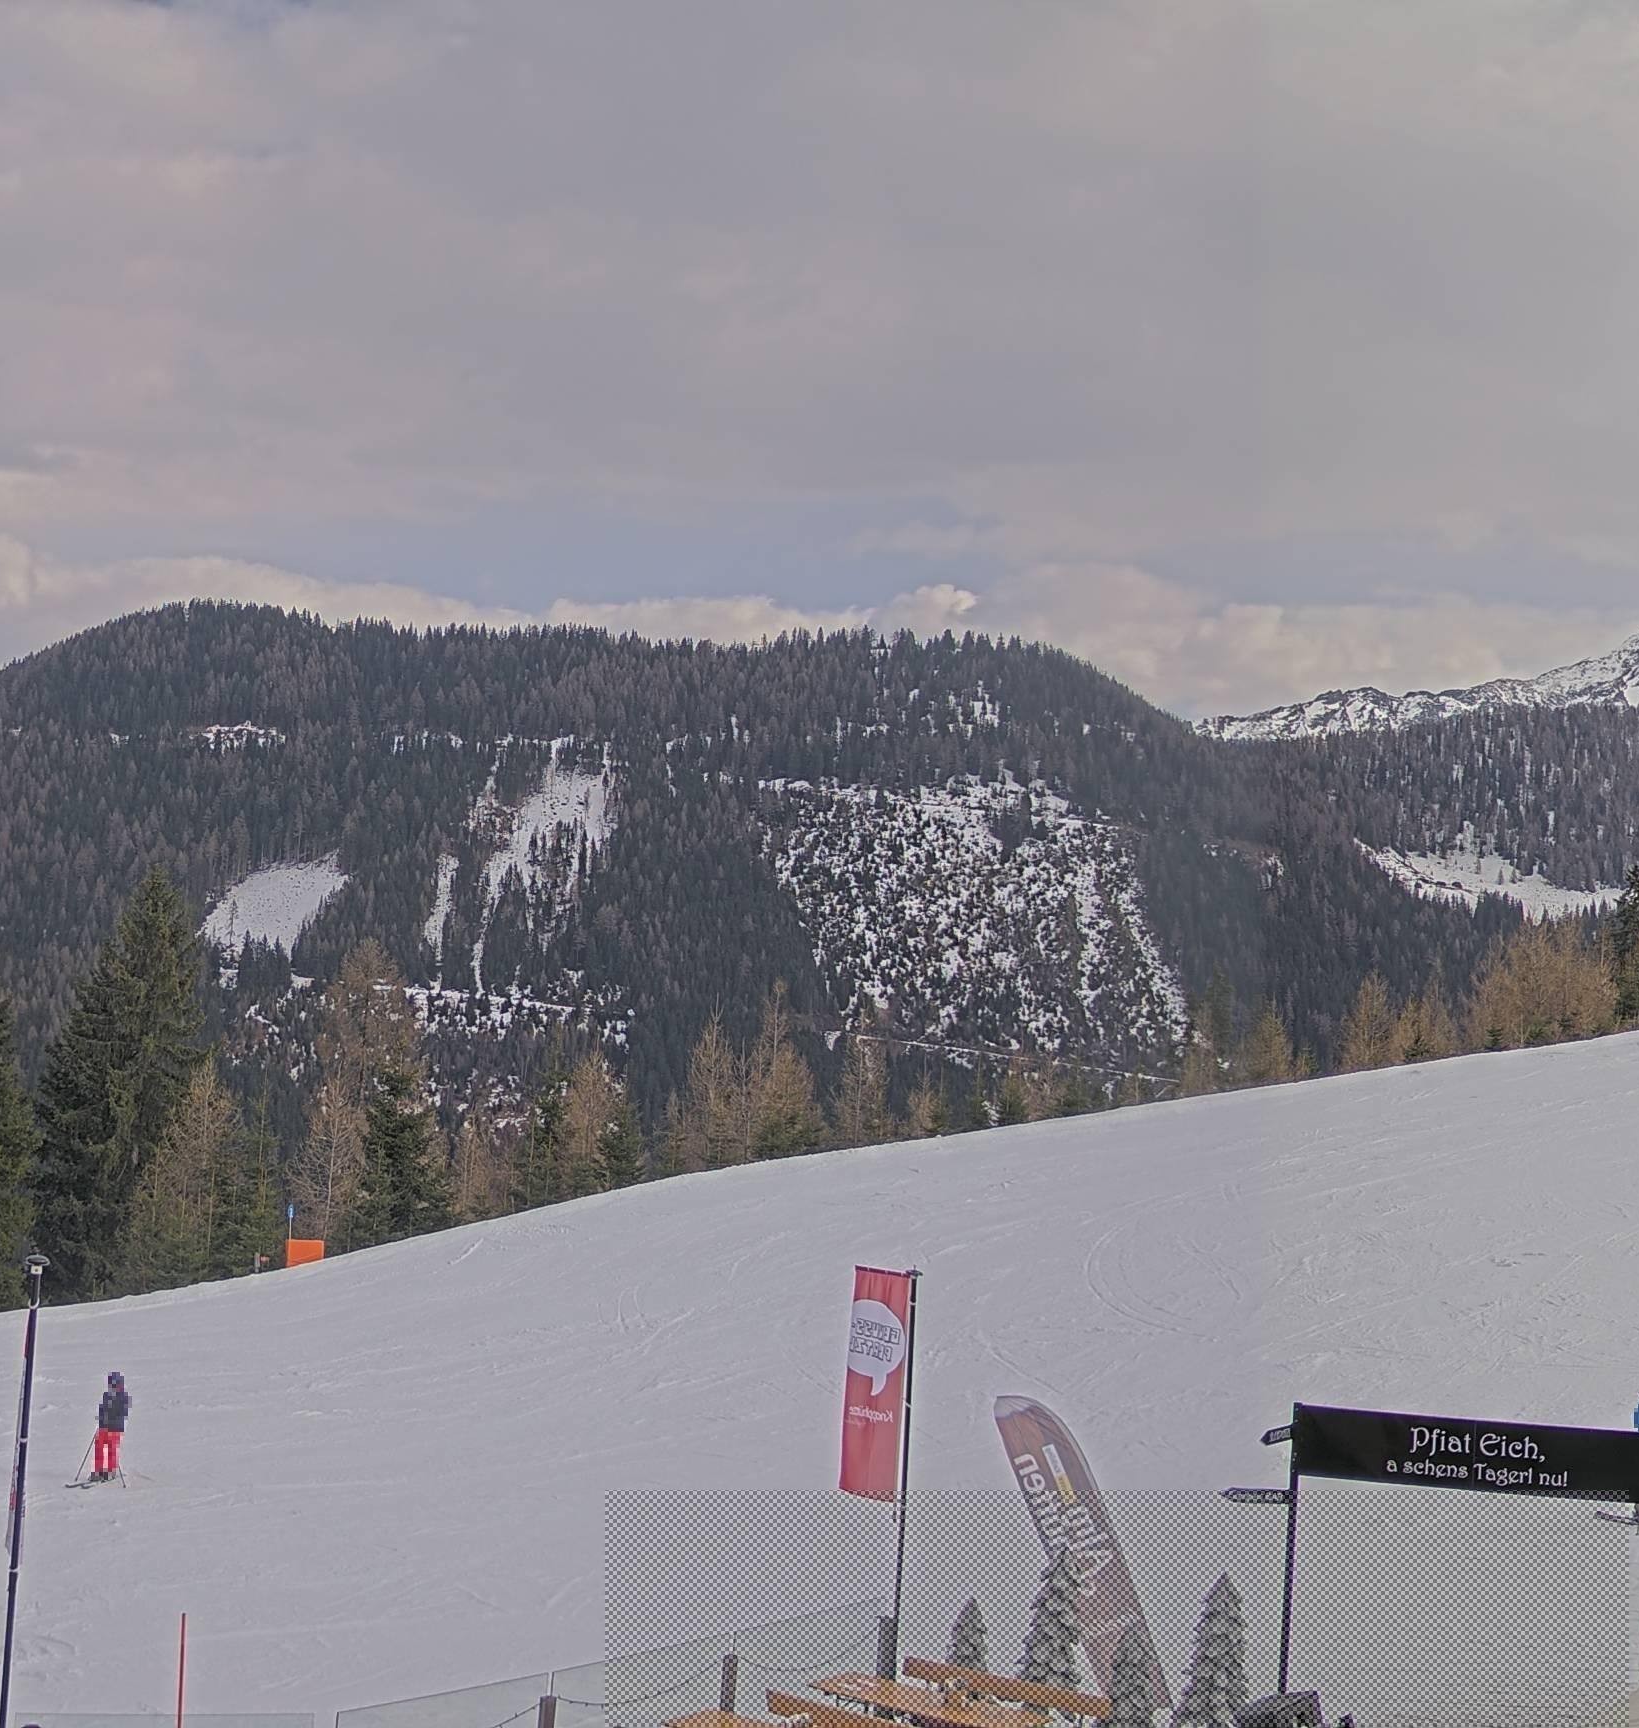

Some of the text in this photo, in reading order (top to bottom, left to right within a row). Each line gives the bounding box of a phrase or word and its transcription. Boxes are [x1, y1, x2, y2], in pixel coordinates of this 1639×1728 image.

[1410, 1427, 1546, 1463] Pfiat Eich,
[1386, 1459, 1568, 1487] a schens Tagerl nu!
